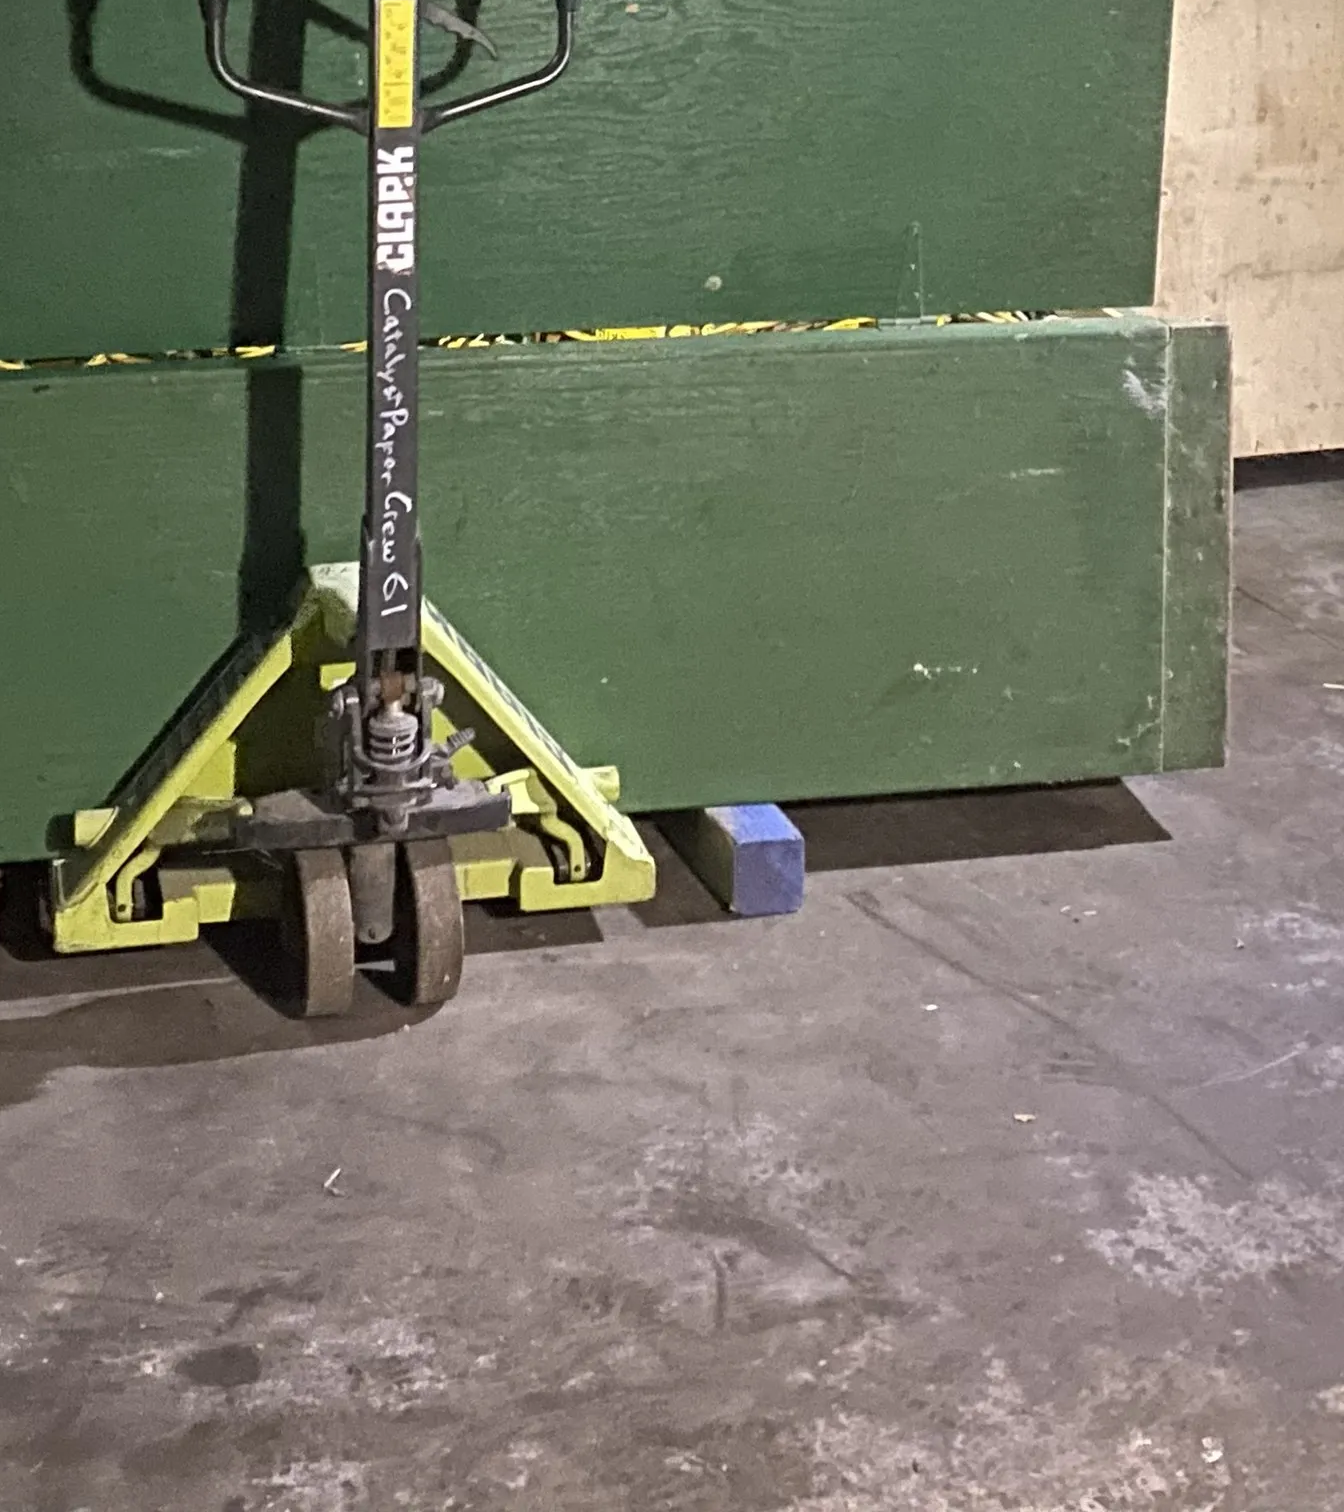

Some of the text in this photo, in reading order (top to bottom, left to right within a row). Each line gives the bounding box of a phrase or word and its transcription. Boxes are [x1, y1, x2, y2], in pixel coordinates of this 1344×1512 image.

[376, 145, 415, 275] CLARK
[374, 287, 413, 617] Catalyst Paper Crew 61
